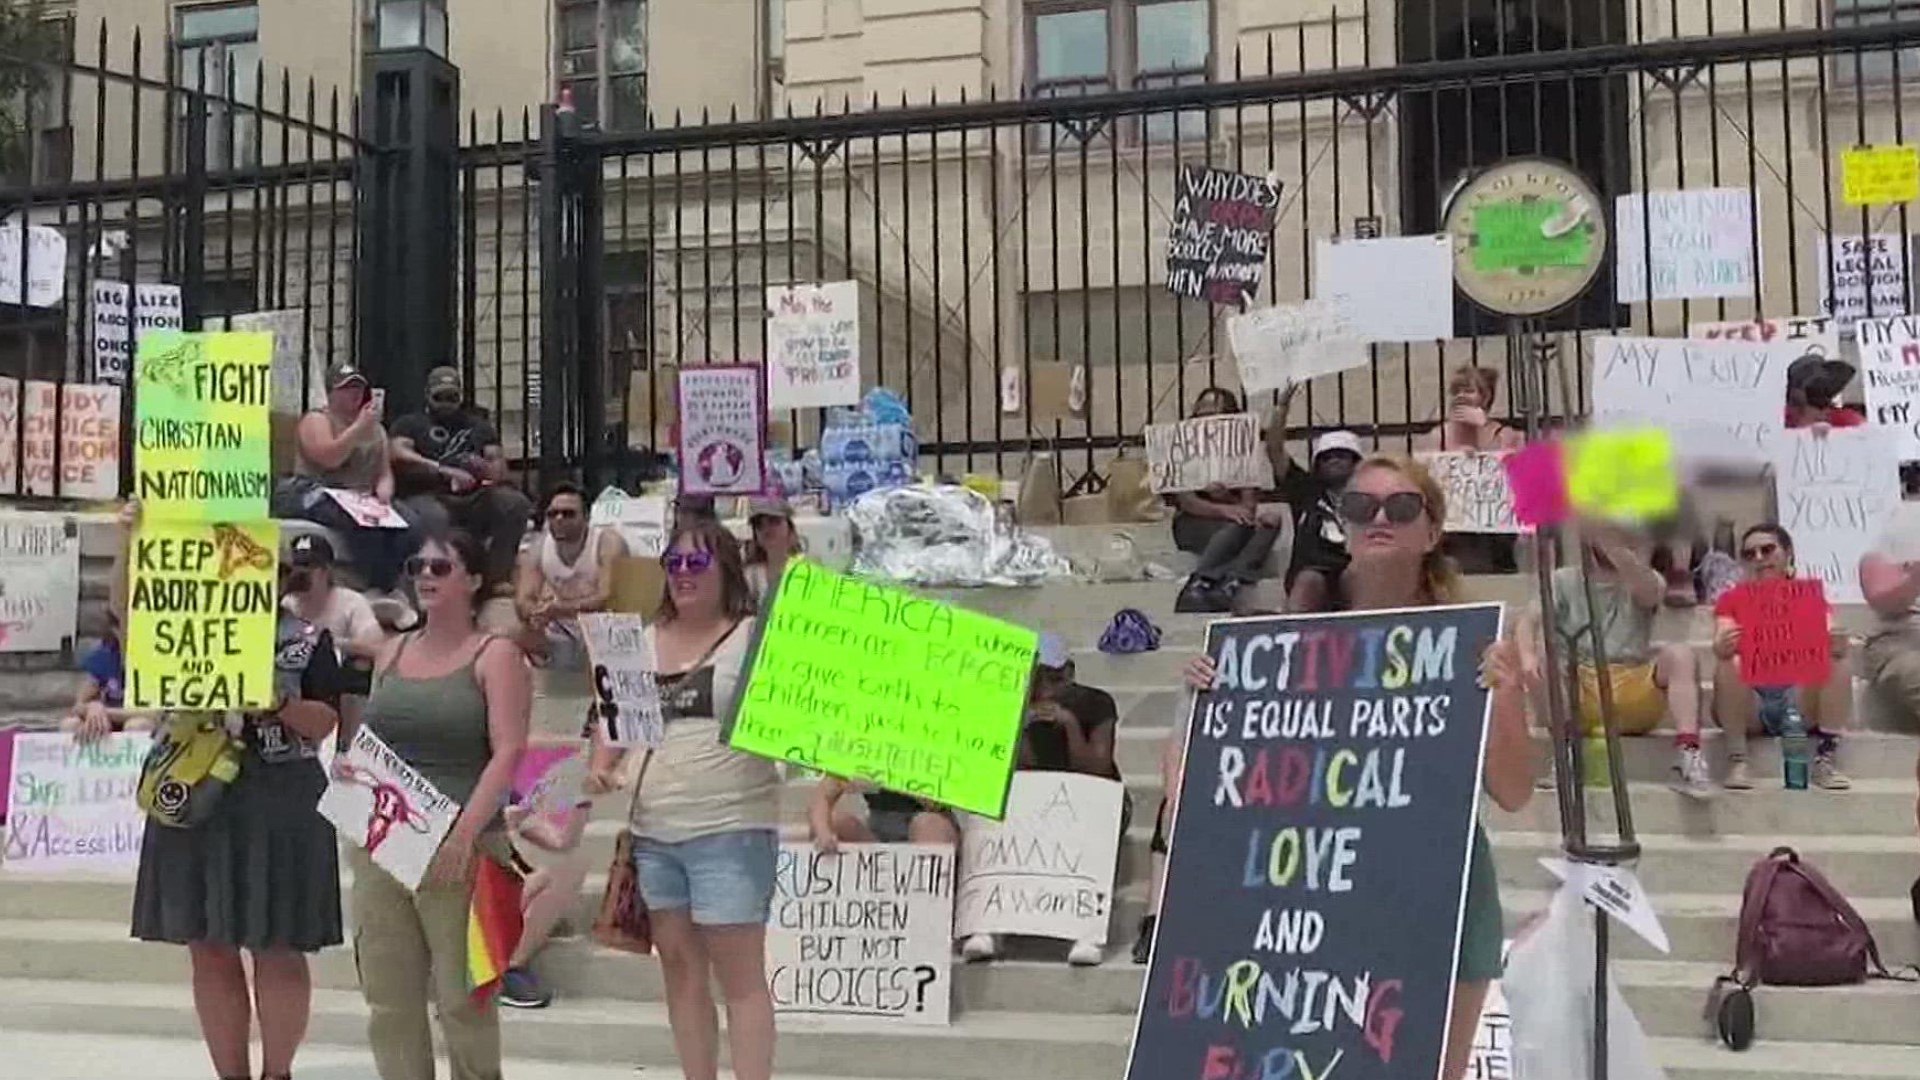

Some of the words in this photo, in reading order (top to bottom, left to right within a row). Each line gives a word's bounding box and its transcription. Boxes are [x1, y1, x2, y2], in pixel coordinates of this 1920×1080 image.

[1177, 195, 1190, 214] A
[1185, 167, 1232, 201] WHY
[1231, 174, 1279, 208] DOES
[1219, 226, 1270, 256] MORE
[97, 289, 179, 309] LEGLIZE
[98, 313, 180, 328] ABOTION
[194, 361, 271, 406] FIGHT
[1603, 343, 1659, 388] MY
[139, 418, 242, 451] CHRISTIAN
[140, 470, 269, 500] NATIONALISM
[138, 539, 214, 571] KEEP
[132, 577, 273, 614] ABORTION
[783, 562, 954, 638] AMERICA
[156, 618, 242, 658] SAFE
[974, 633, 1033, 663] where
[1210, 625, 1458, 691] ACTIVISM
[181, 660, 214, 675] AND
[790, 661, 845, 688] give
[931, 689, 961, 713] to
[132, 669, 259, 708] LEGAL
[1203, 701, 1233, 739] IS
[1241, 699, 1337, 740] EQUAL
[1350, 695, 1451, 738] PARTS
[1214, 747, 1412, 809] RADICAL
[1041, 781, 1079, 823] A
[4, 813, 28, 861] &
[775, 850, 849, 898] RUST
[855, 850, 890, 894] ME
[892, 852, 953, 899] WITH
[1242, 826, 1362, 892] LOVE
[780, 900, 908, 931] CHILDREN
[1253, 908, 1325, 954] AND
[800, 934, 847, 962] BUT
[861, 936, 907, 961] NOT
[770, 964, 938, 1013] CHOICES?
[1167, 956, 1405, 1064] BURNING
